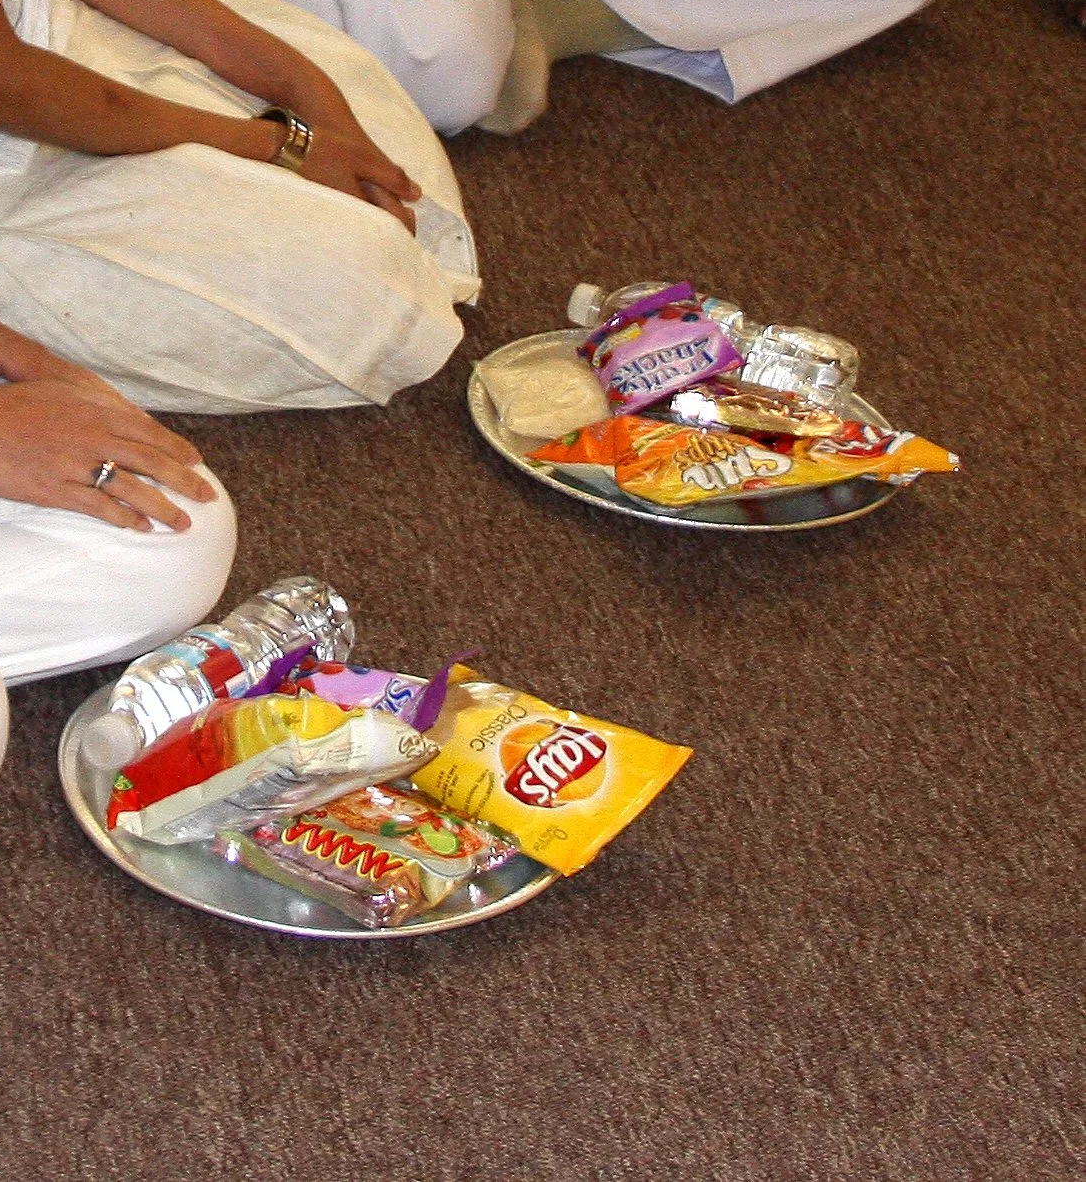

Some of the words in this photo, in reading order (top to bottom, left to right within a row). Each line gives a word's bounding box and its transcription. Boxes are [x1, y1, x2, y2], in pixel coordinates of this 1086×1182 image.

[468, 703, 528, 753] Classic
[518, 724, 604, 805] Lay's
[281, 819, 406, 883] MAMA
